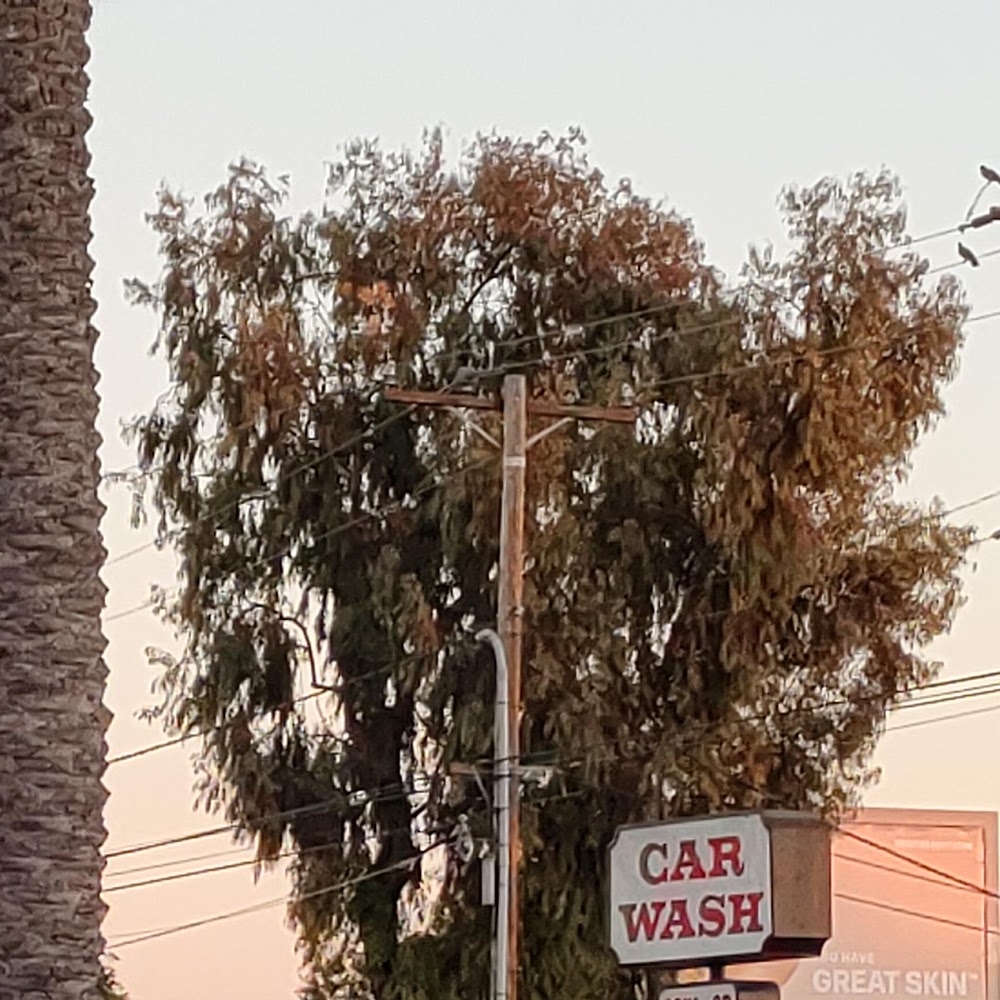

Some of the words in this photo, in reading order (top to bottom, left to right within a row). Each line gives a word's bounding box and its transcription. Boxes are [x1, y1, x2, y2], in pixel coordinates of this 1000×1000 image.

[639, 836, 744, 885] CAR
[619, 892, 763, 943] WASH
[812, 969, 900, 994] GREAT
